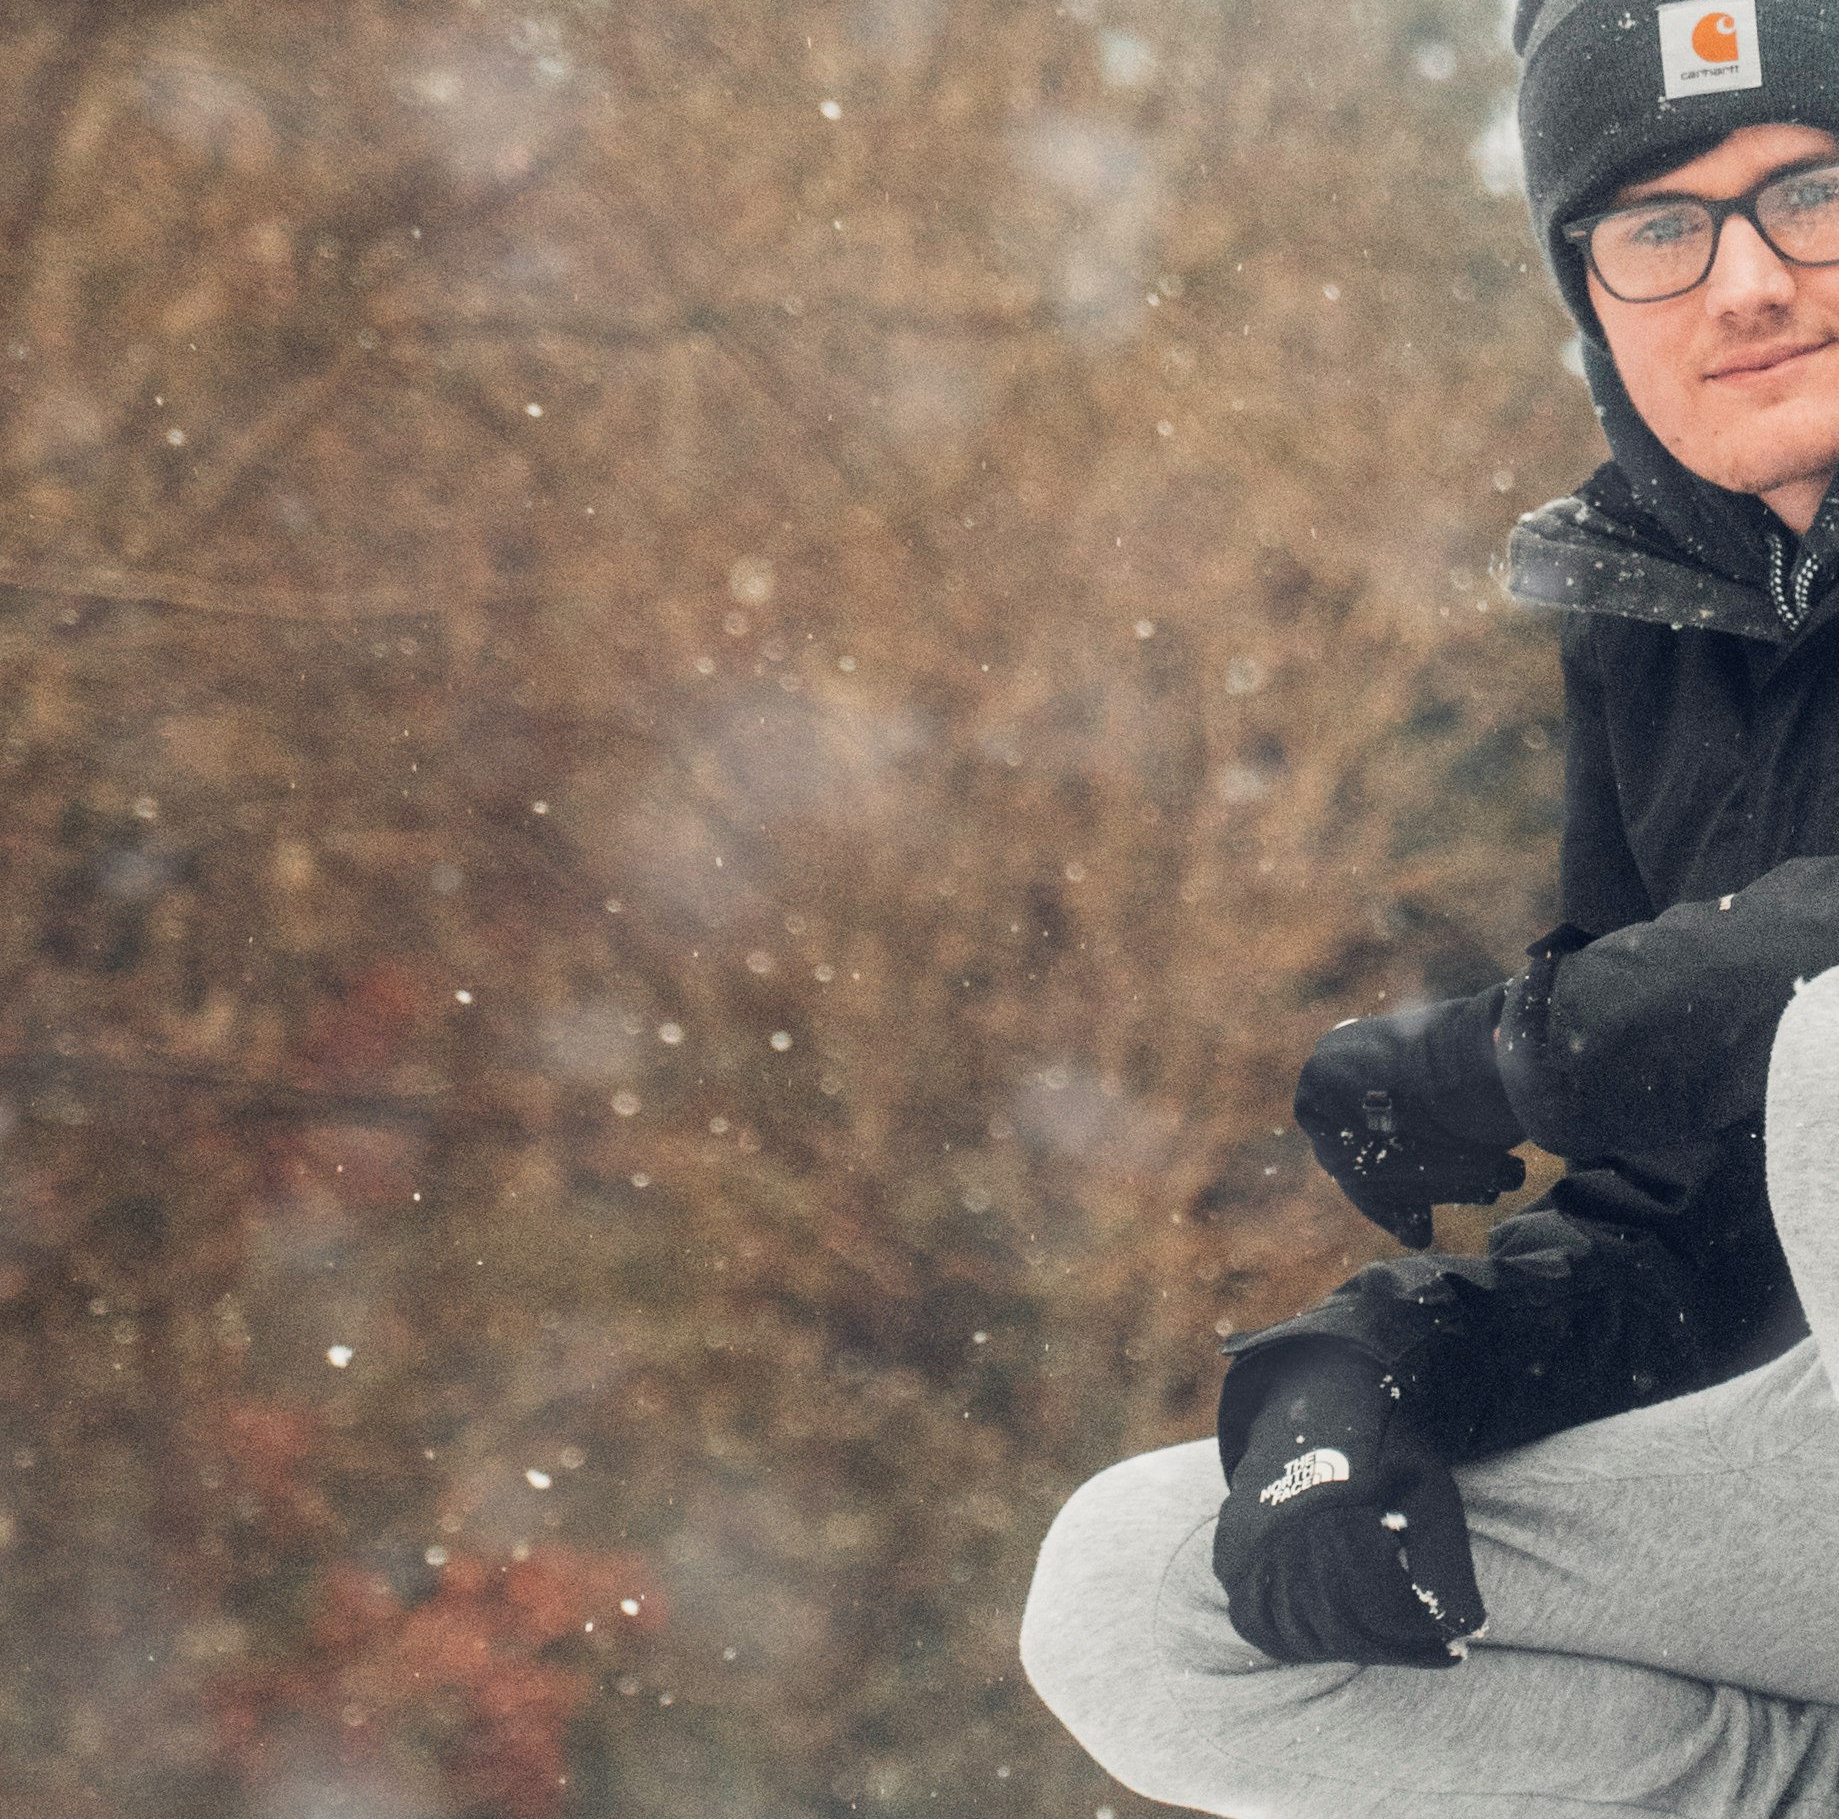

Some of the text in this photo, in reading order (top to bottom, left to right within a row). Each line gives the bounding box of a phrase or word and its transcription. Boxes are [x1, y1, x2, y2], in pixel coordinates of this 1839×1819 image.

[1680, 65, 1739, 80] carhartt
[1284, 1452, 1315, 1476] THE
[1260, 1464, 1315, 1503] NORTH
[1271, 1478, 1313, 1506] FACE
